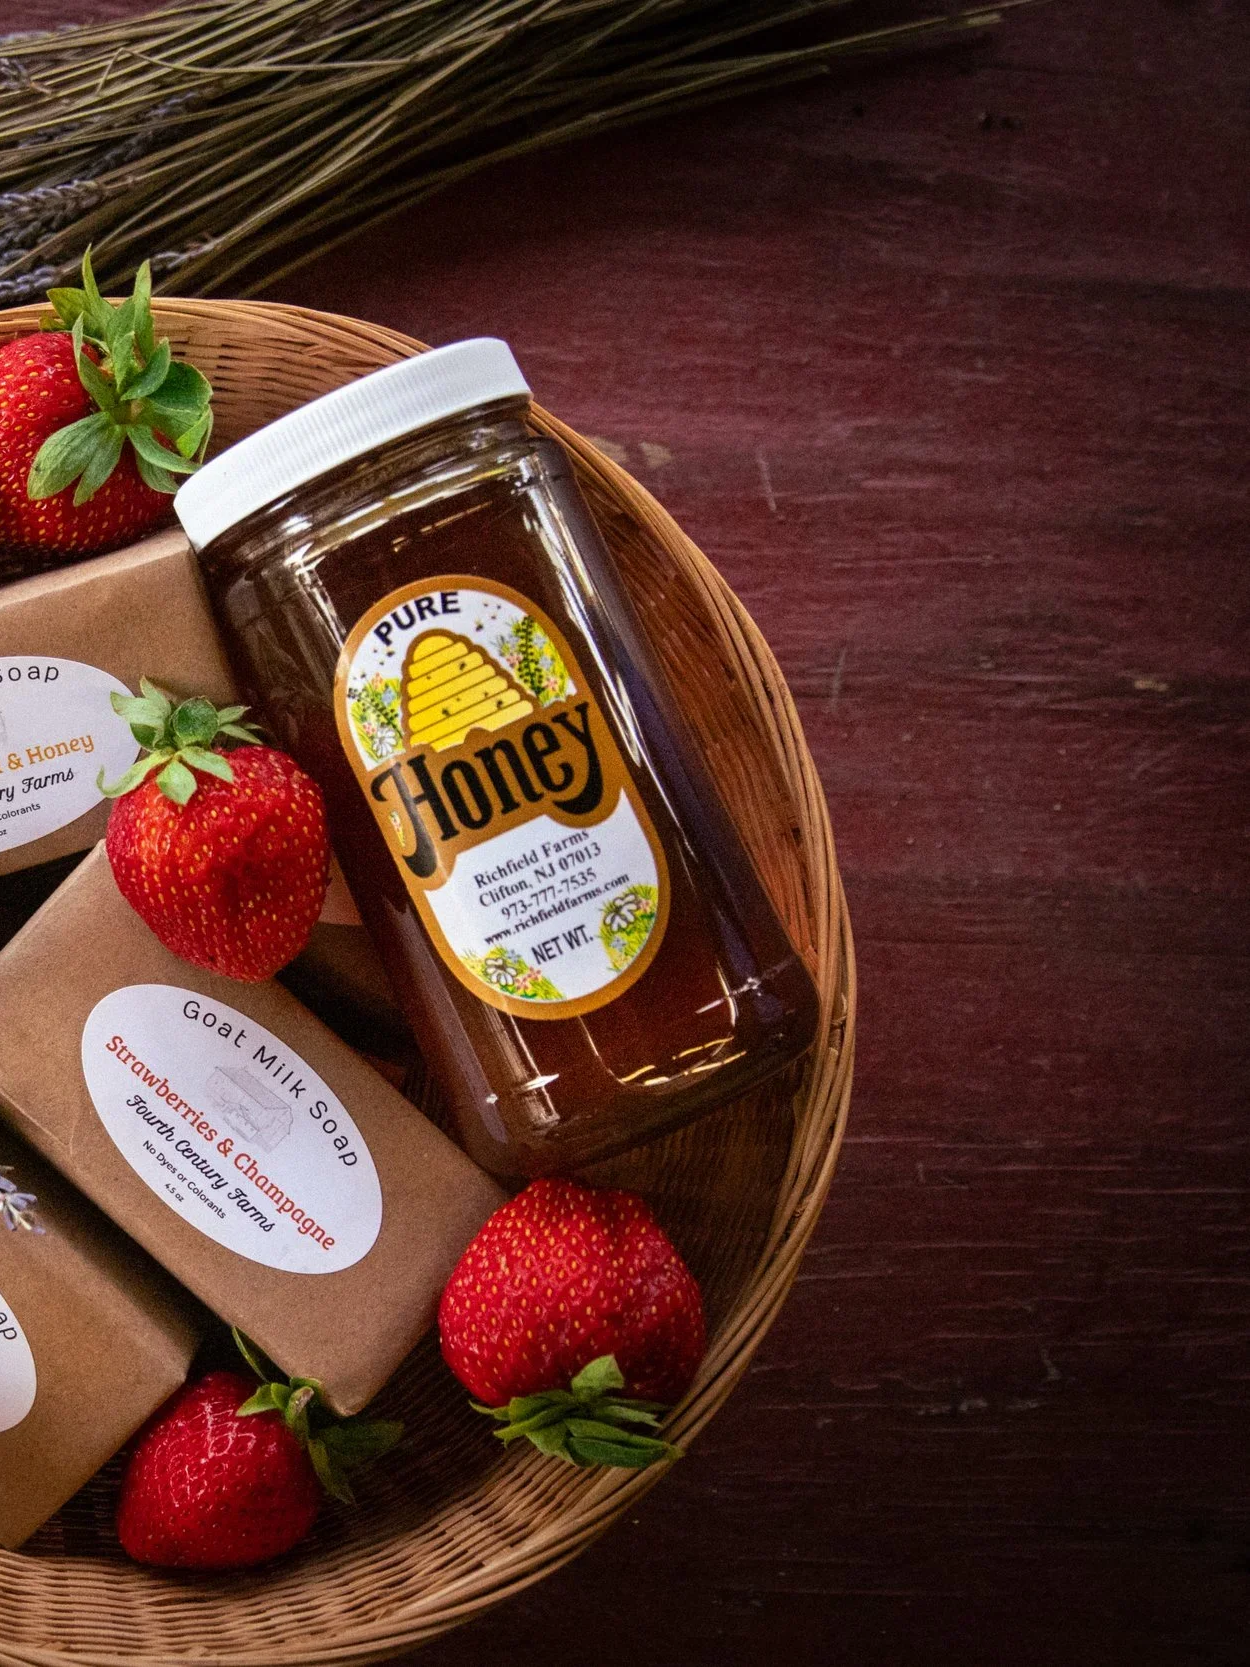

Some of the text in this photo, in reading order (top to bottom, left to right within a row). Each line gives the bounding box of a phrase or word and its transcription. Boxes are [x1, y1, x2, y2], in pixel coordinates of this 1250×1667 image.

[373, 591, 461, 647] PURE
[7, 753, 23, 769] &
[26, 734, 94, 766] Honey
[22, 768, 75, 793] Farms
[371, 701, 605, 878] Honey
[473, 830, 591, 890] Richfield Farms
[478, 842, 602, 908] Clifton, NJ 07013
[483, 874, 630, 946] www.richfieldfarms.com
[501, 868, 597, 920] 973-777-7535
[531, 924, 595, 964] NET WT.
[183, 1000, 358, 1167] Goat Milk Soap
[105, 1036, 335, 1250] Strawberries & Champagne
[126, 1095, 275, 1233] Fourth Century Farms
[143, 1140, 226, 1220] No Dyes or Colorants
[164, 1183, 183, 1203] 4.5 oz
